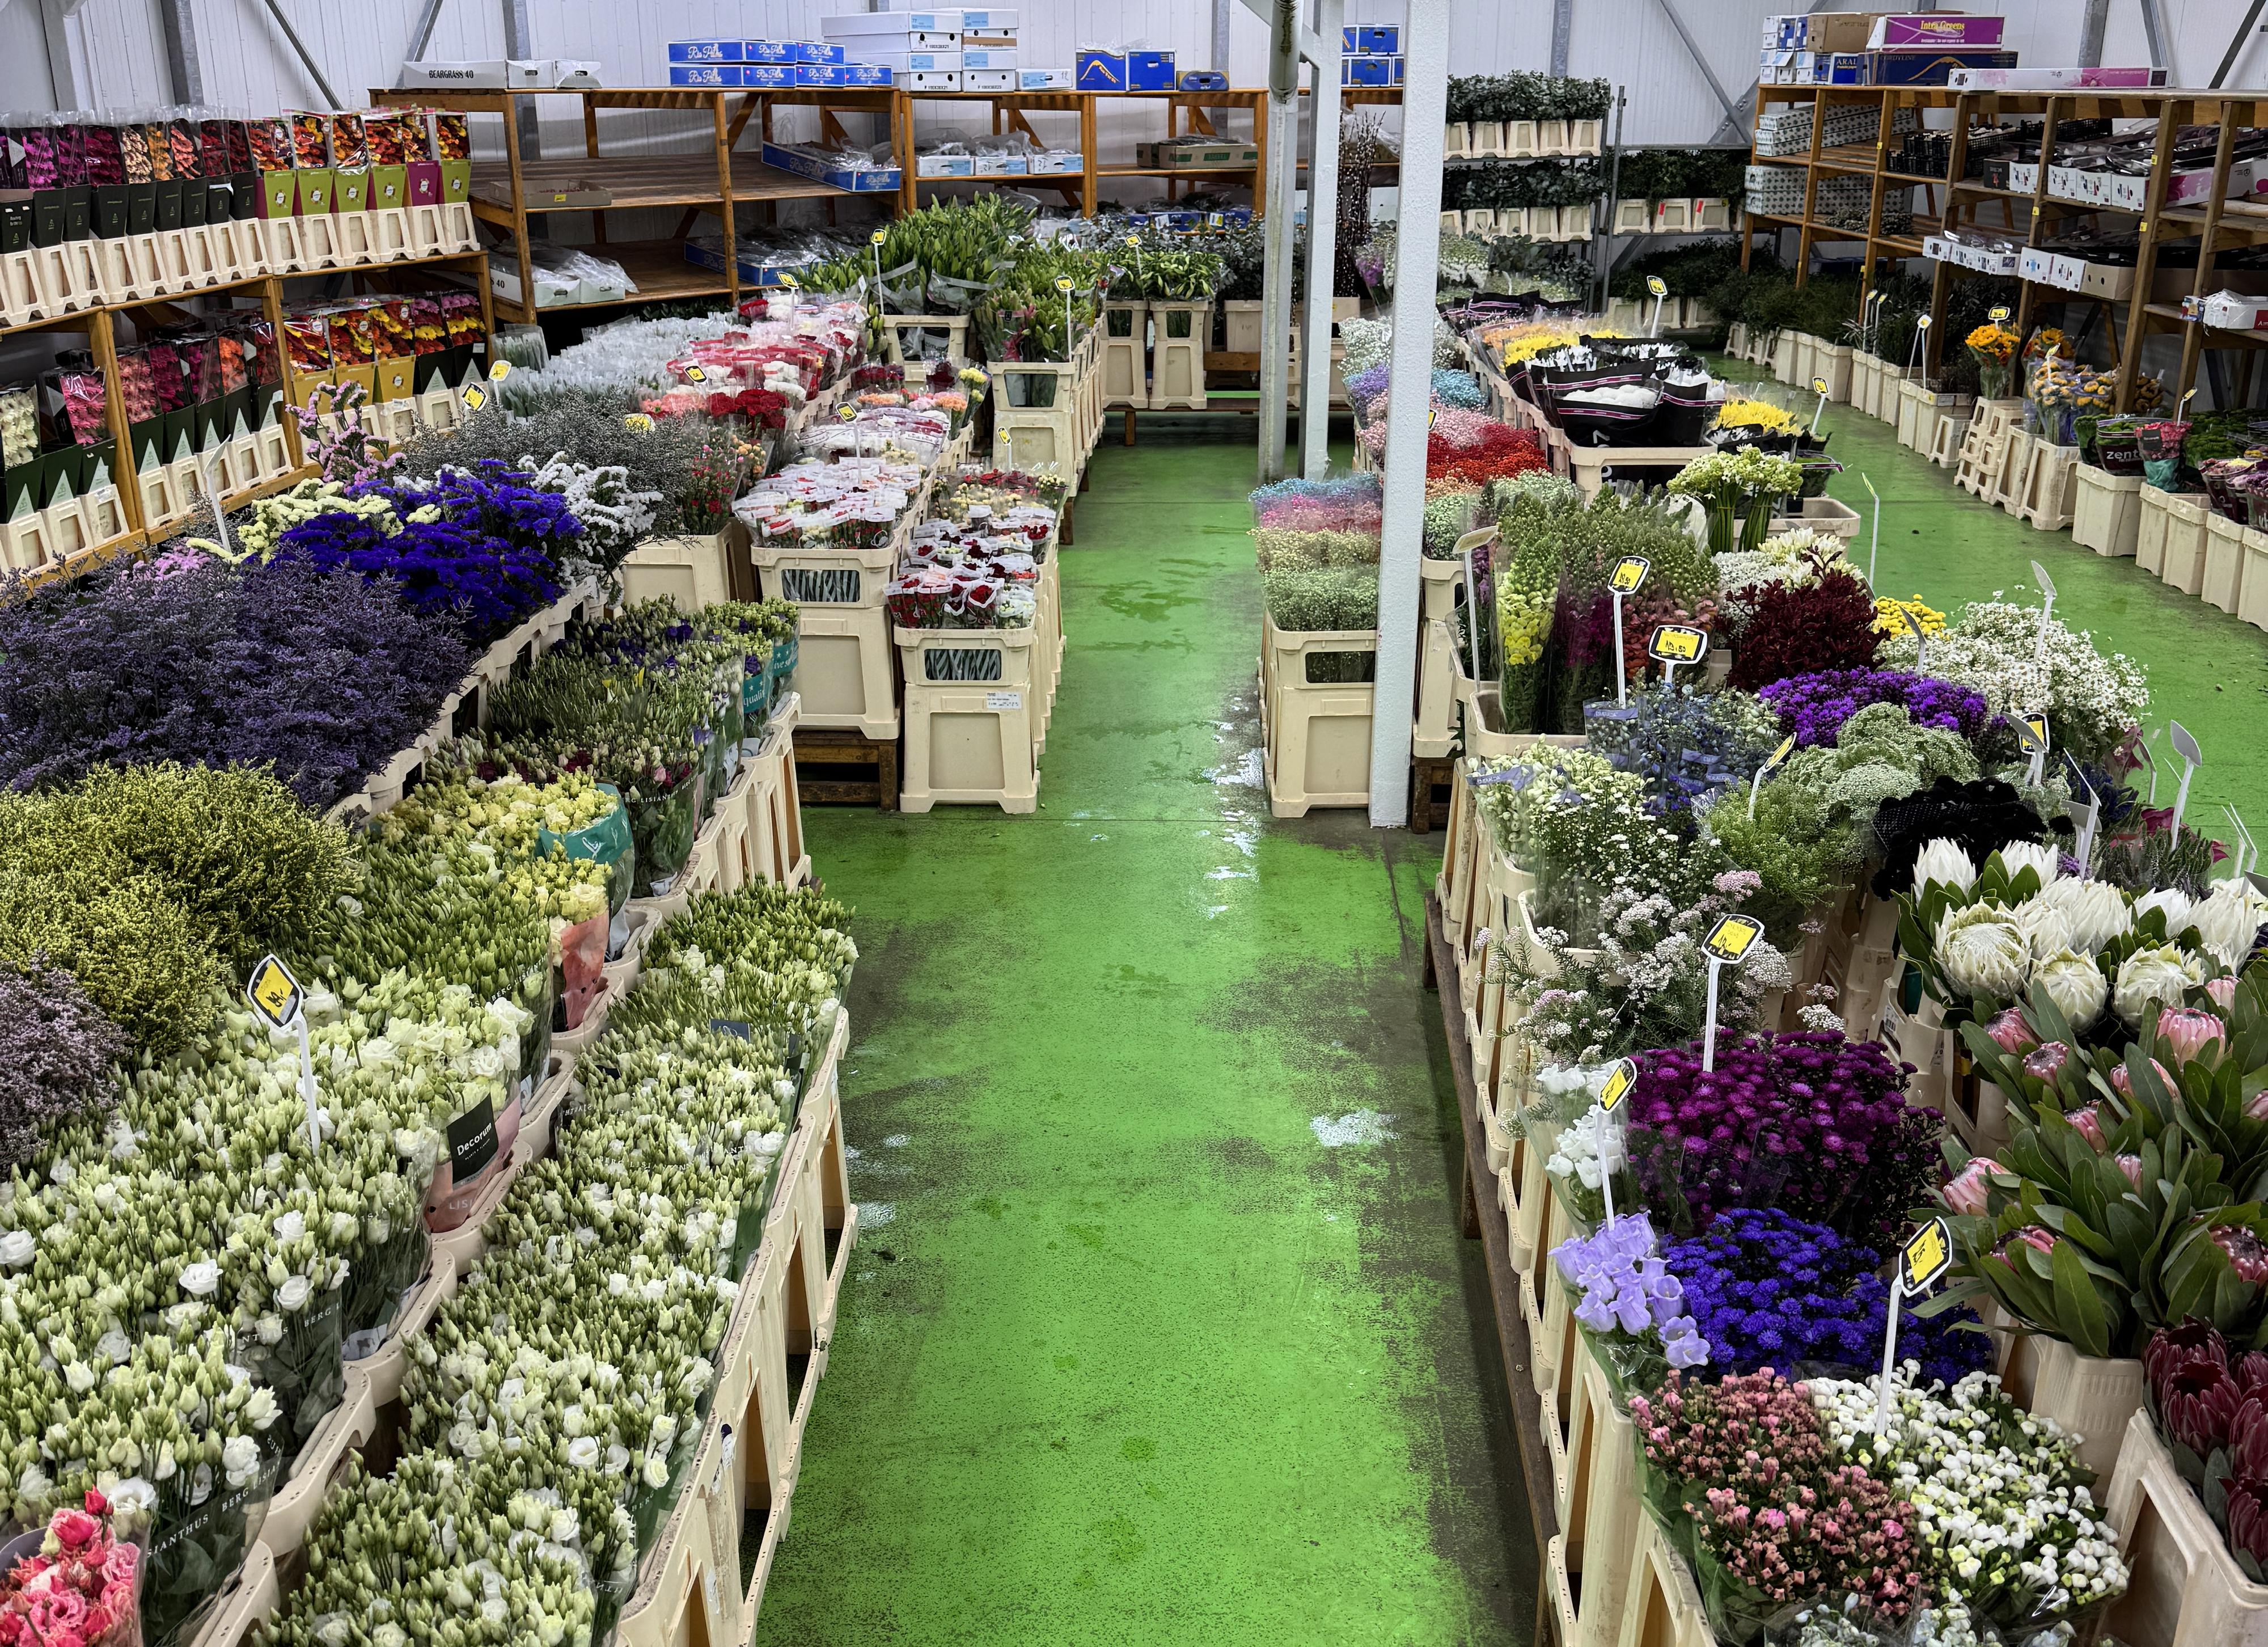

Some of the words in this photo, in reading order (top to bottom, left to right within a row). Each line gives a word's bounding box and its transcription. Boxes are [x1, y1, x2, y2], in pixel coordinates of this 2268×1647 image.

[1920, 20, 1938, 29] Intra
[429, 70, 463, 78] BEARGRASS
[465, 70, 474, 78] 40
[496, 279, 505, 288] 40
[2106, 449, 2142, 460] zent
[456, 1122, 492, 1156] Decorum
[304, 1307, 331, 1327] BERG
[221, 1487, 249, 1513] BERG
